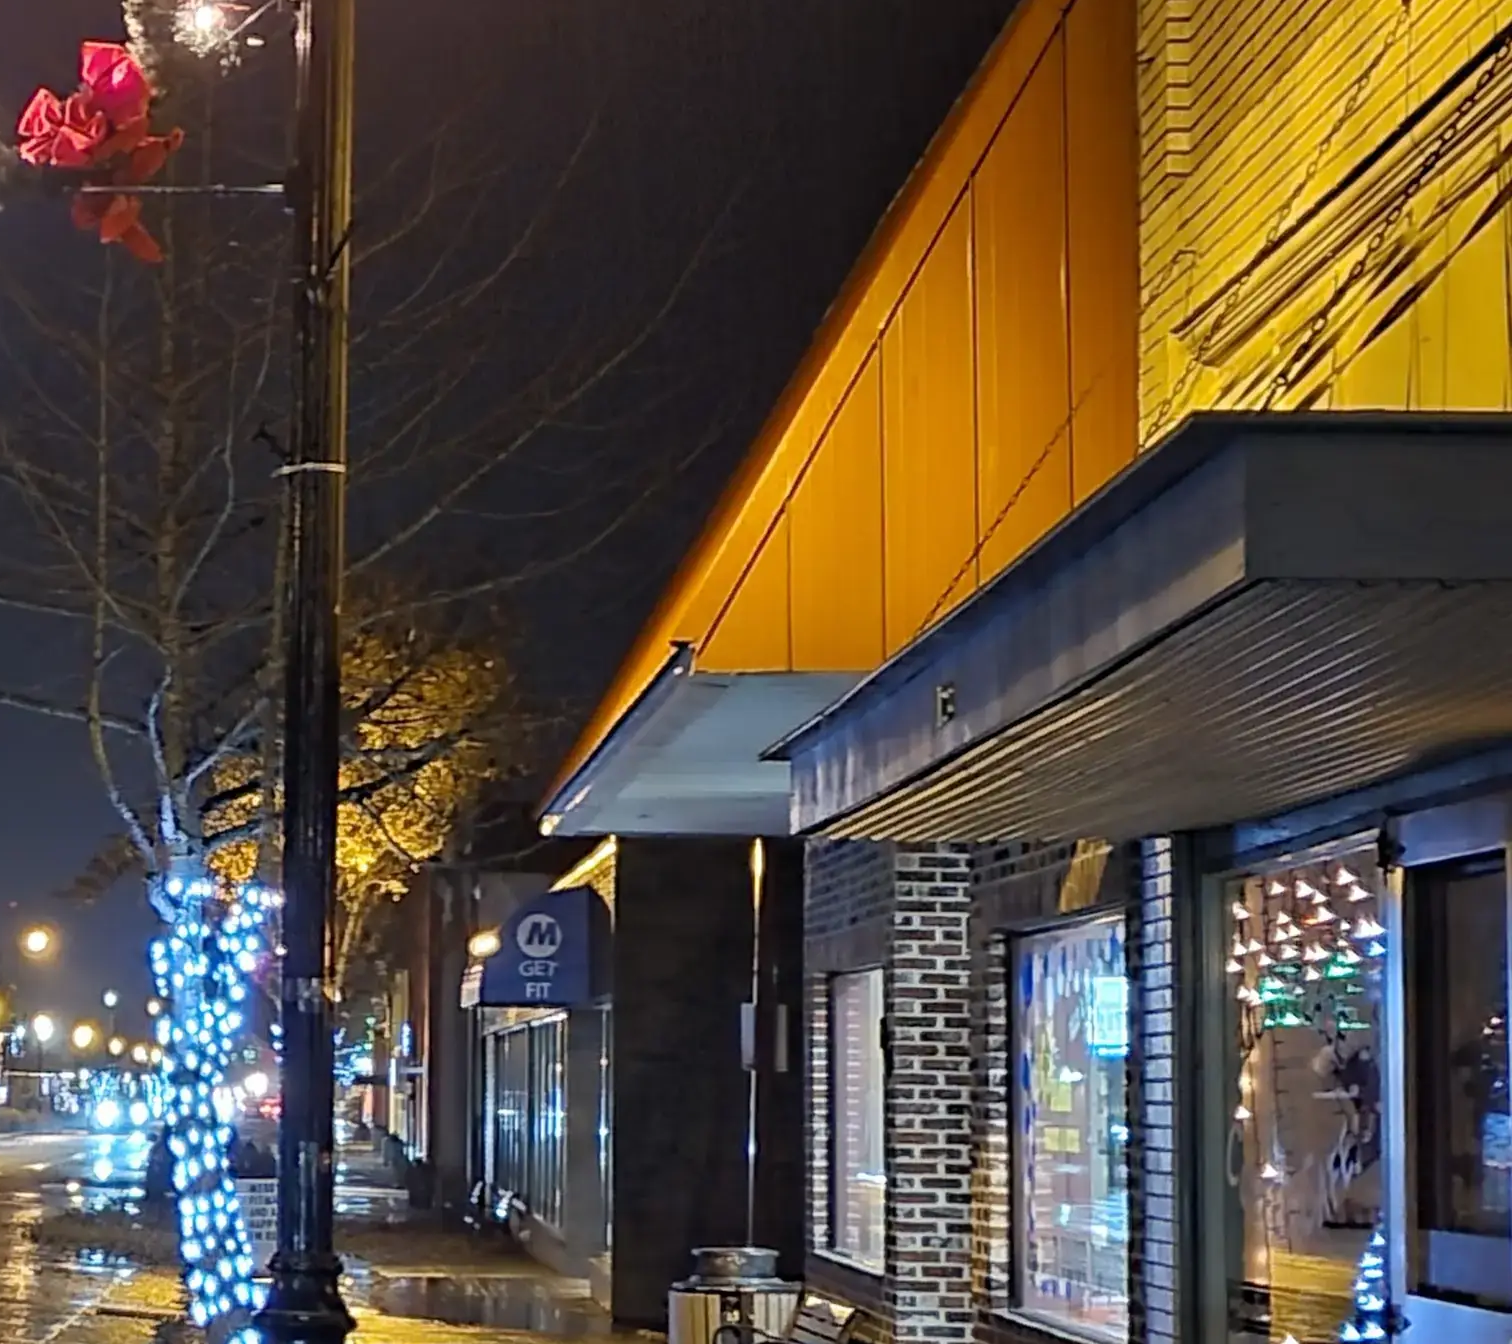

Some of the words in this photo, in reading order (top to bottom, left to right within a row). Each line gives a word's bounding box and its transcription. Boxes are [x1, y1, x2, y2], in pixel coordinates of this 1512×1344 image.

[525, 921, 557, 946] M
[518, 960, 559, 977] GET
[524, 982, 552, 999] FIT
